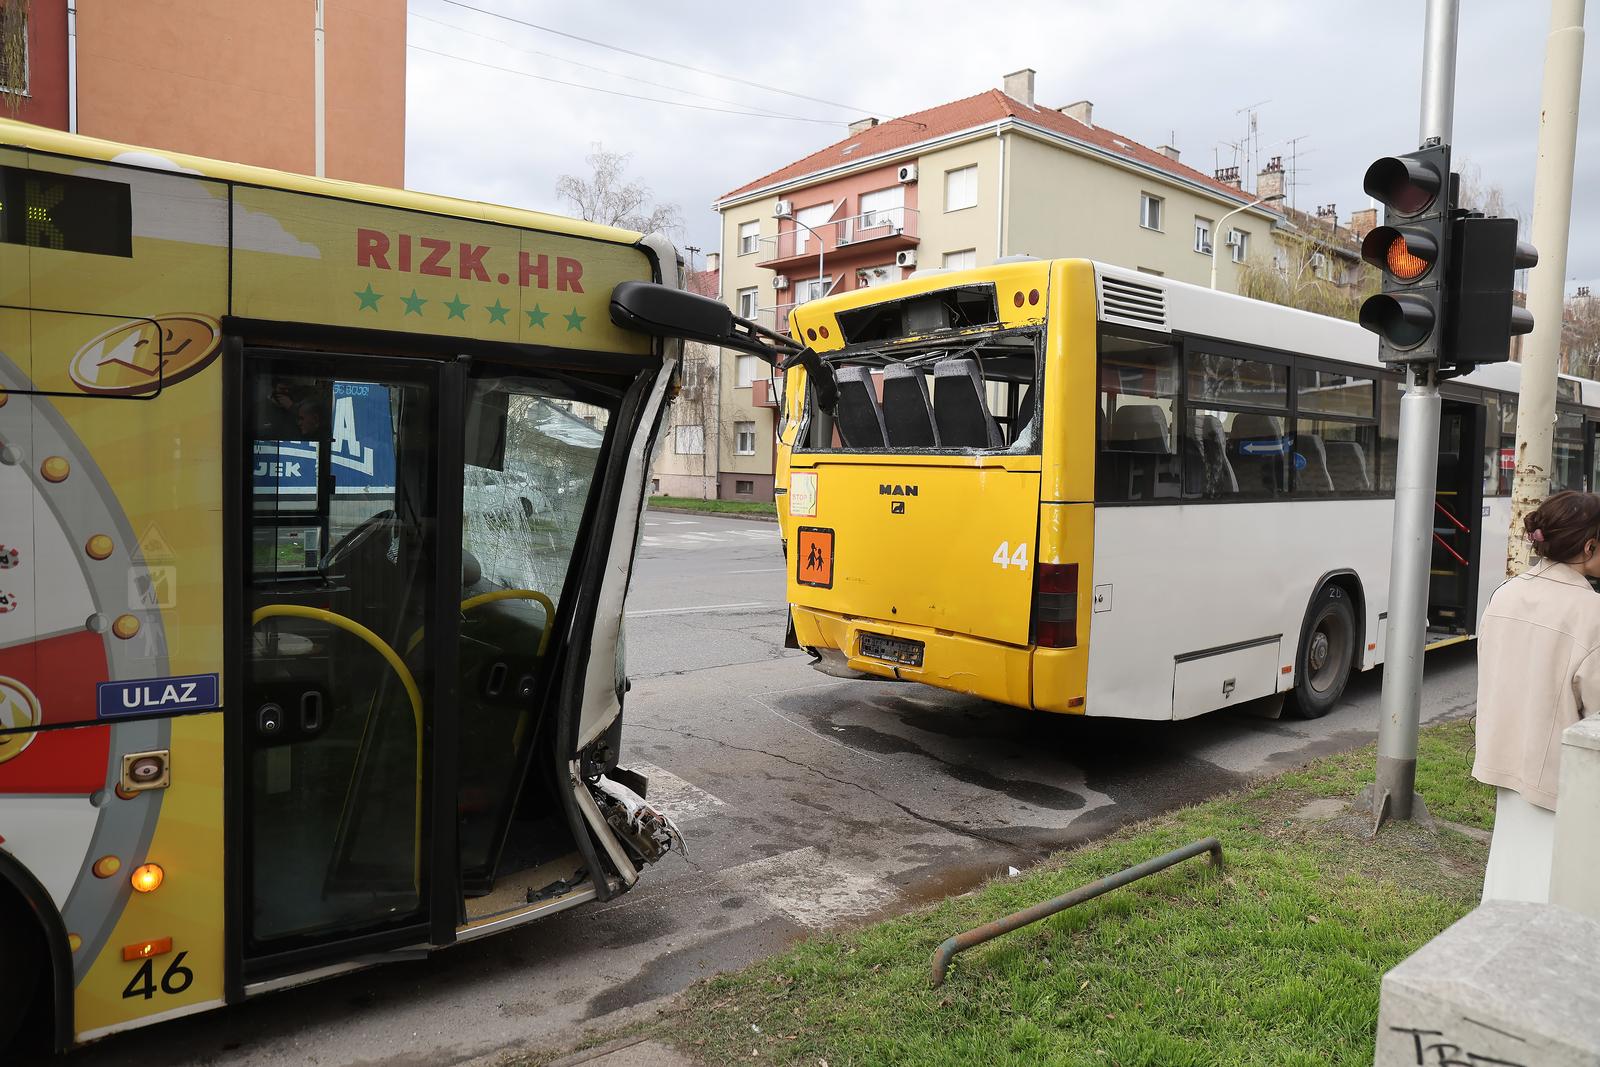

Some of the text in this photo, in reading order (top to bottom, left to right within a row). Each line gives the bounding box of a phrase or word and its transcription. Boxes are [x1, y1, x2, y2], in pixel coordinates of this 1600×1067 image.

[357, 228, 585, 294] RIZK.HR
[879, 484, 919, 497] MAN
[992, 540, 1029, 571] 44
[122, 682, 197, 708] ULAZ
[122, 951, 194, 1000] 46
